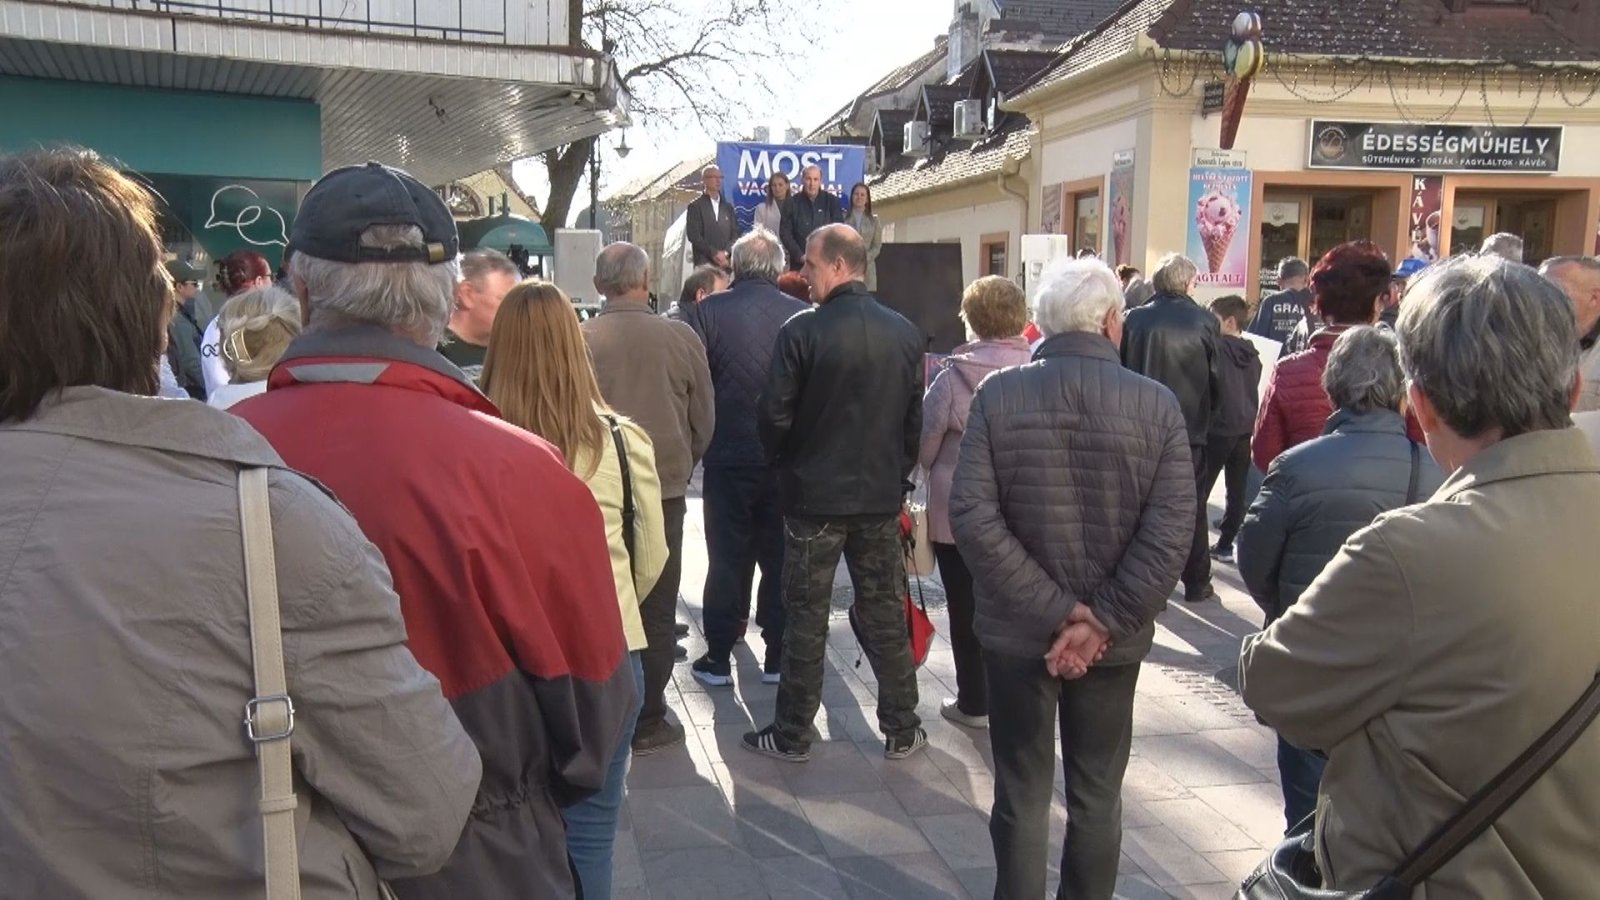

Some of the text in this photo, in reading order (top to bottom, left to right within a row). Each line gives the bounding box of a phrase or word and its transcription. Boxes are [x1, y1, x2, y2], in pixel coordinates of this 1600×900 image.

[1362, 127, 1550, 155] ÉDESSÉGMŰHELY
[737, 149, 843, 182] MOST
[1362, 154, 1547, 167] SÜTEMÉNYEK TORTÁK FAGYLALTOK KÁVÉK
[1195, 273, 1241, 282] AGYLALT
